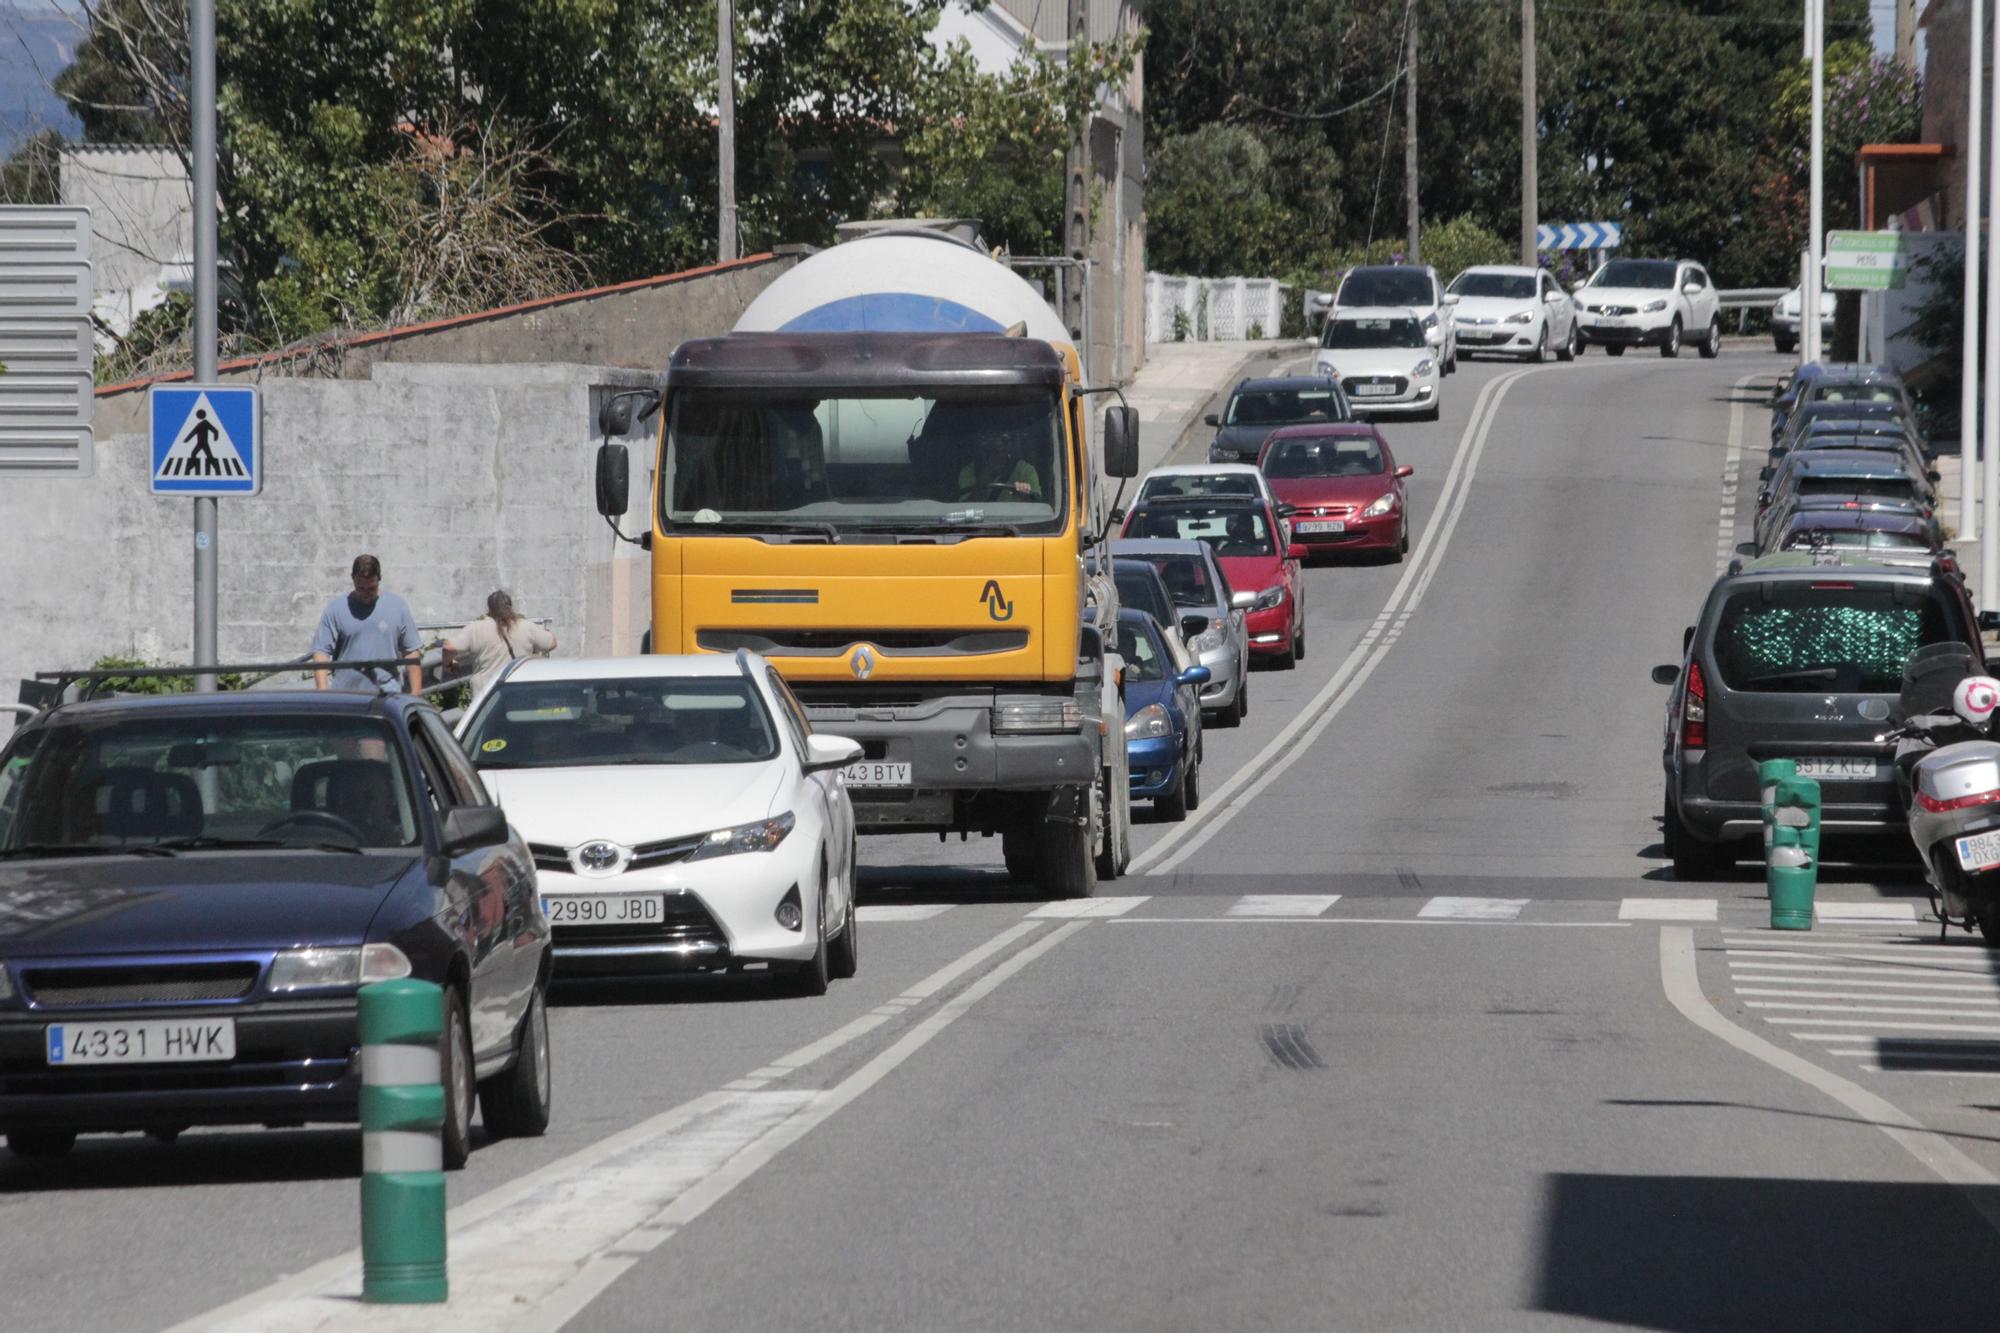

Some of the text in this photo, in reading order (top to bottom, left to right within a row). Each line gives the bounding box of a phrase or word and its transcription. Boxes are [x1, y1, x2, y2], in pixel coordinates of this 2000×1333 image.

[874, 765, 906, 780] BTV
[1840, 758, 1872, 774] KLZ
[552, 899, 657, 921] 2990 JBD
[72, 1025, 223, 1058] 4331 HVK
